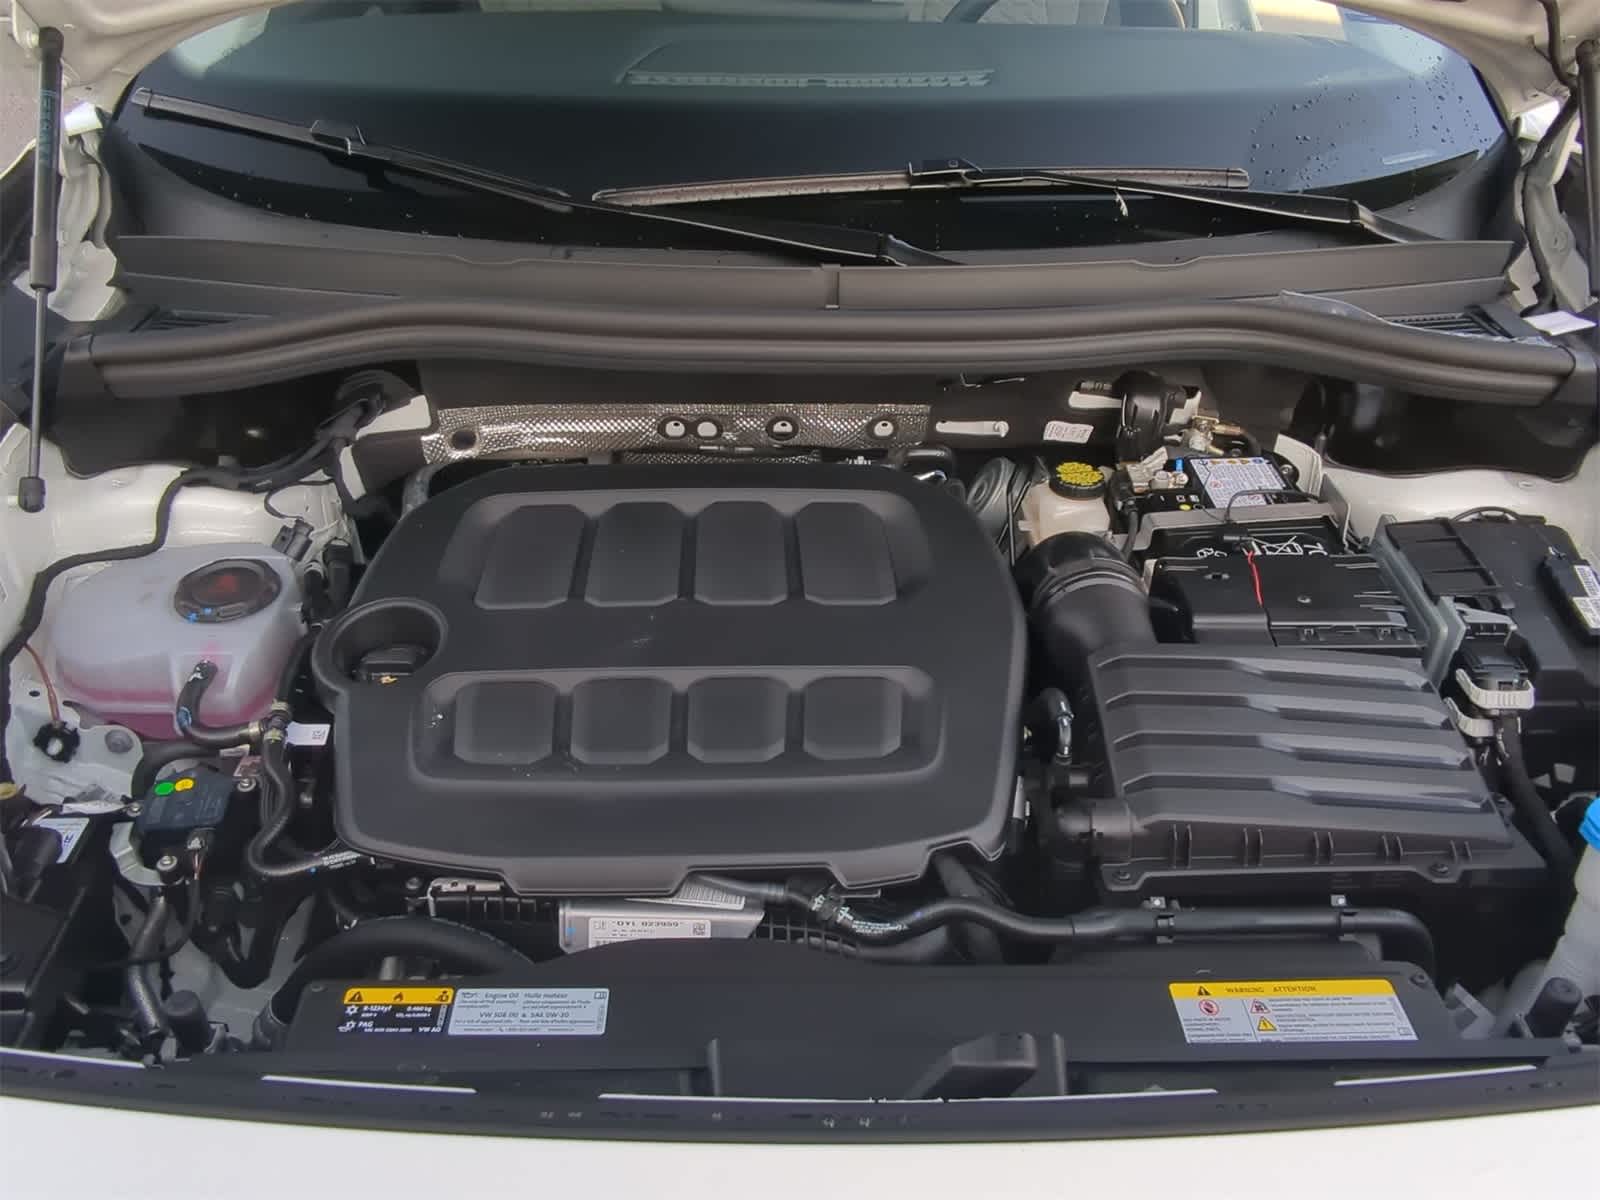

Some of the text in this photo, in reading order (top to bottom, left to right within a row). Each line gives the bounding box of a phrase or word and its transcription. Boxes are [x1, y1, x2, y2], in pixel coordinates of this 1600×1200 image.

[1225, 985, 1317, 994] WARNING ATTENTION
[485, 992, 508, 1000] Engine
[358, 1020, 374, 1028] PAG
